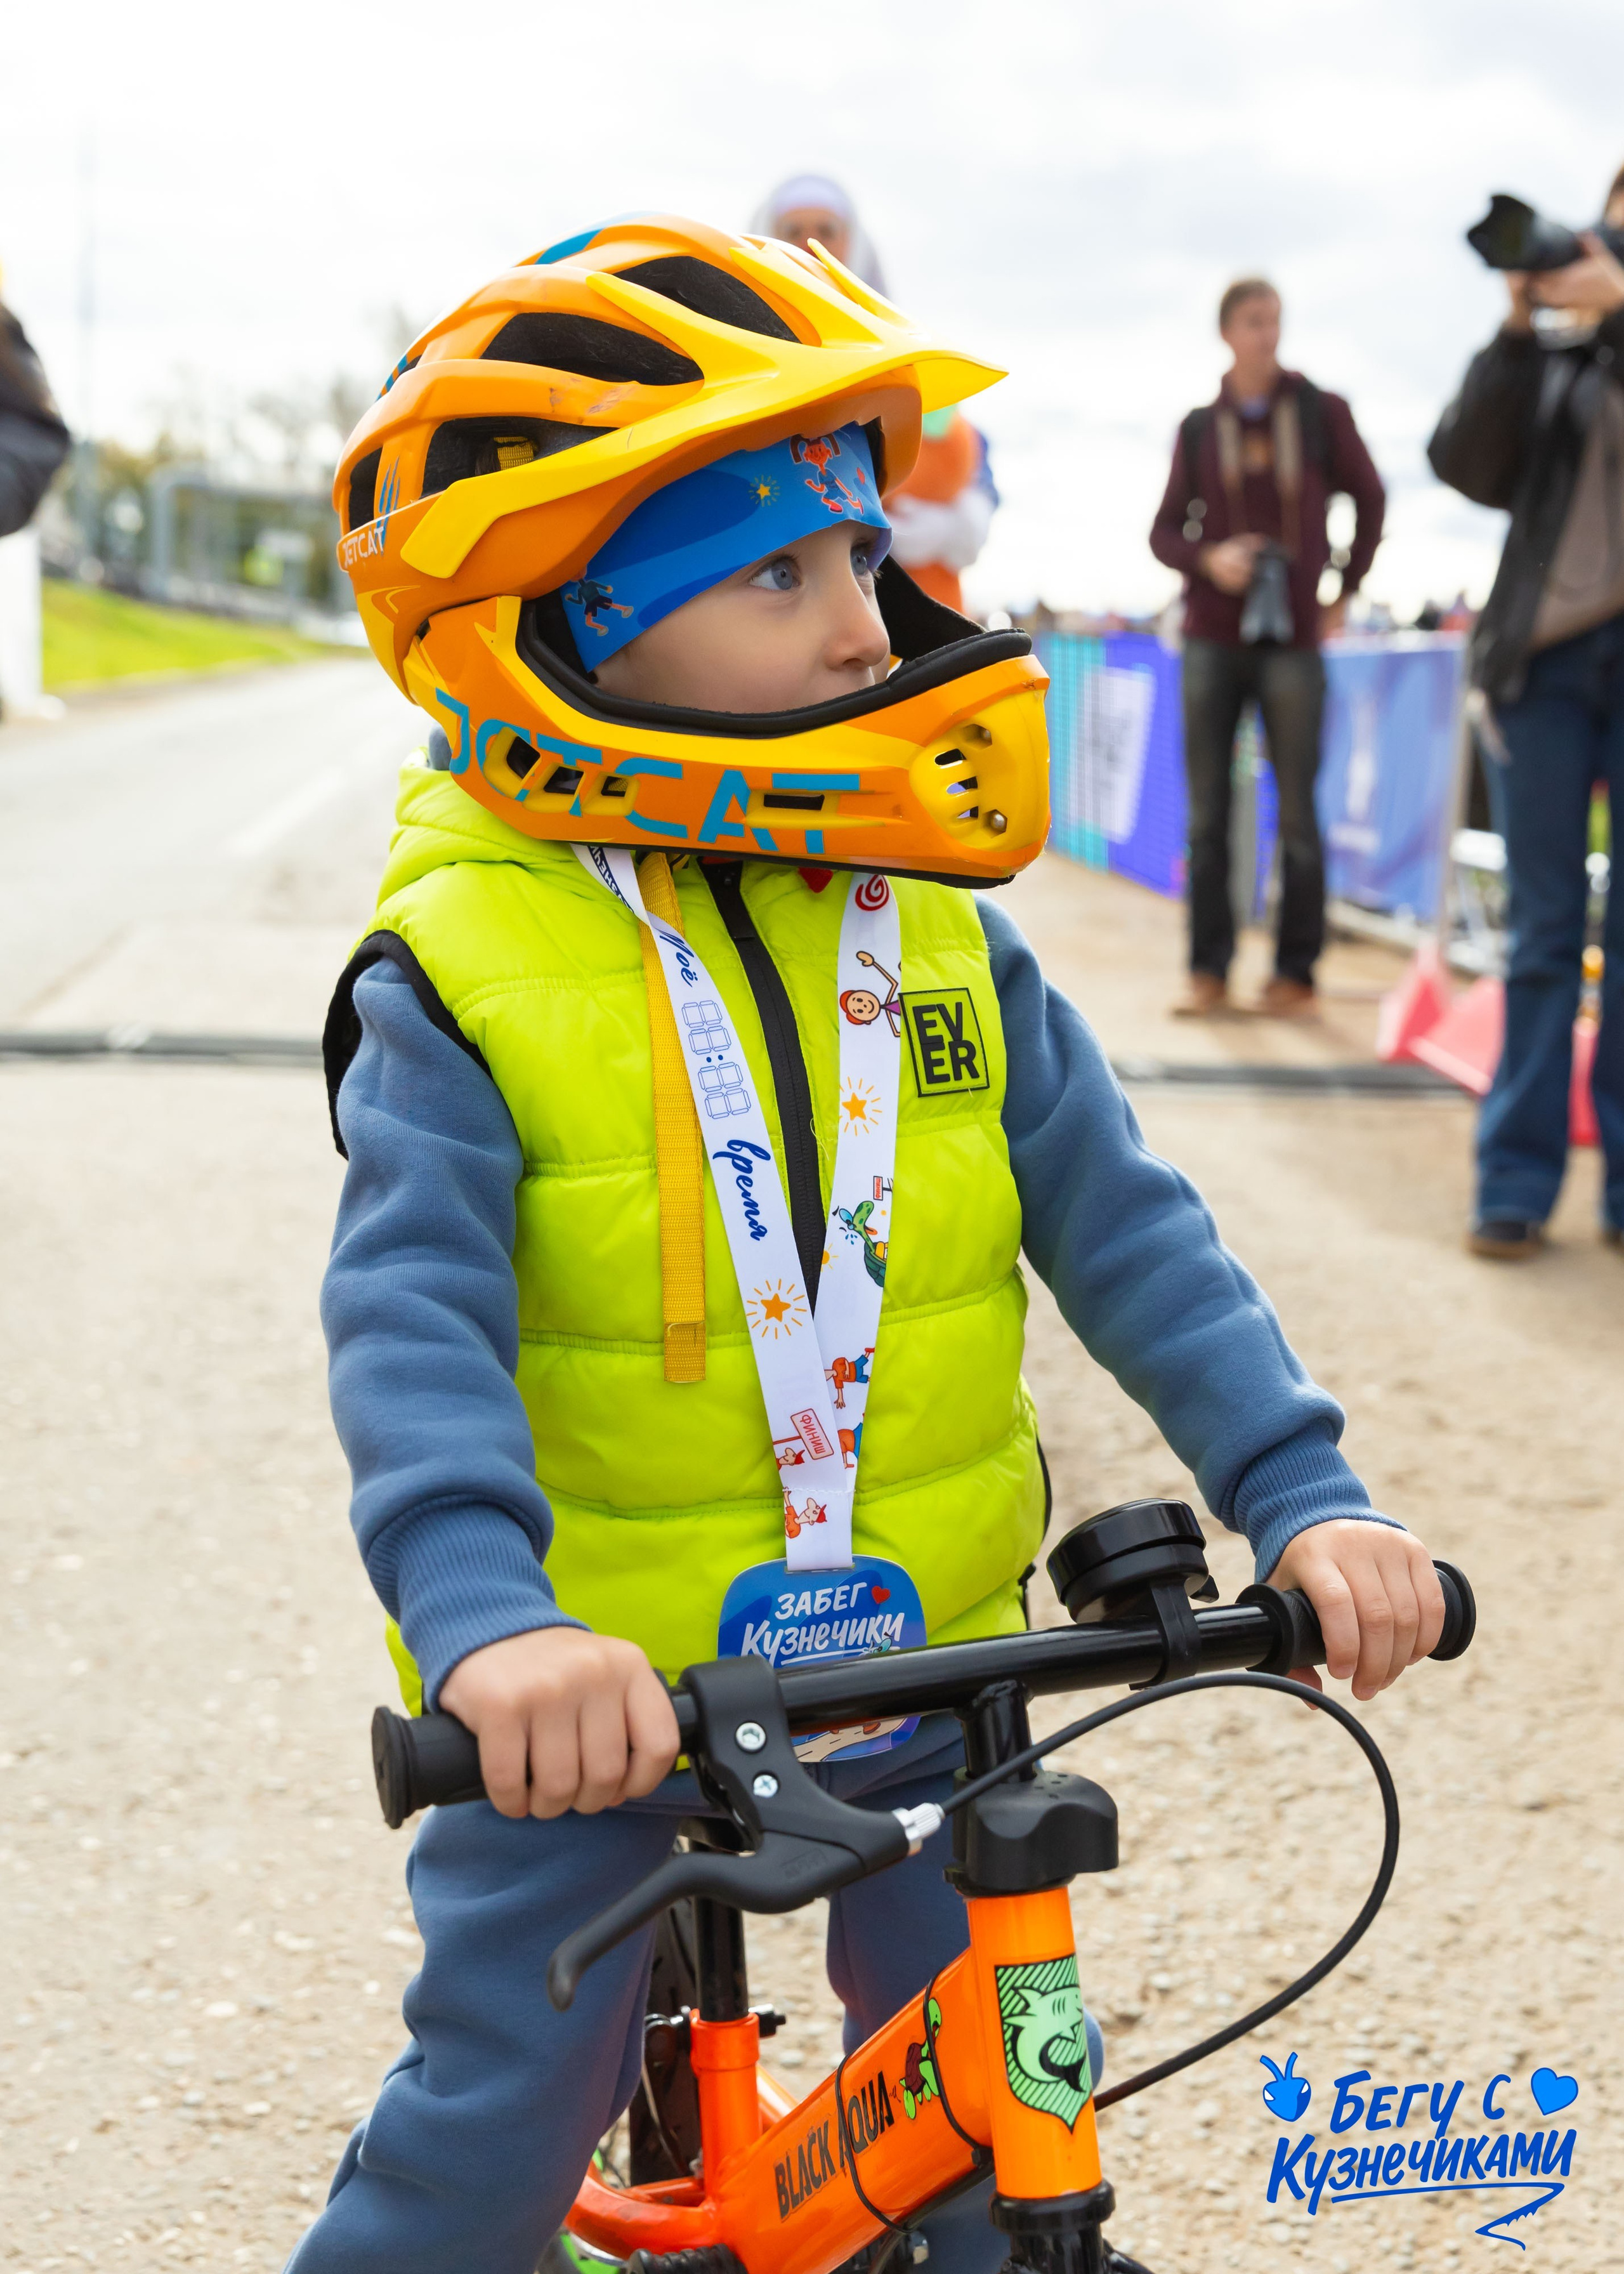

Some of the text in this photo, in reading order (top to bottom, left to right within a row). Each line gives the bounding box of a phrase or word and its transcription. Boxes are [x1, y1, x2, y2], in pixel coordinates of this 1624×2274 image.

[343, 526, 384, 568] JETCAT
[712, 1139, 771, 1241] время
[800, 1414, 826, 1454] ФИНИШ
[775, 1582, 867, 1620] ЗАБЕГ
[775, 2070, 895, 2219] BLACK AQUA
